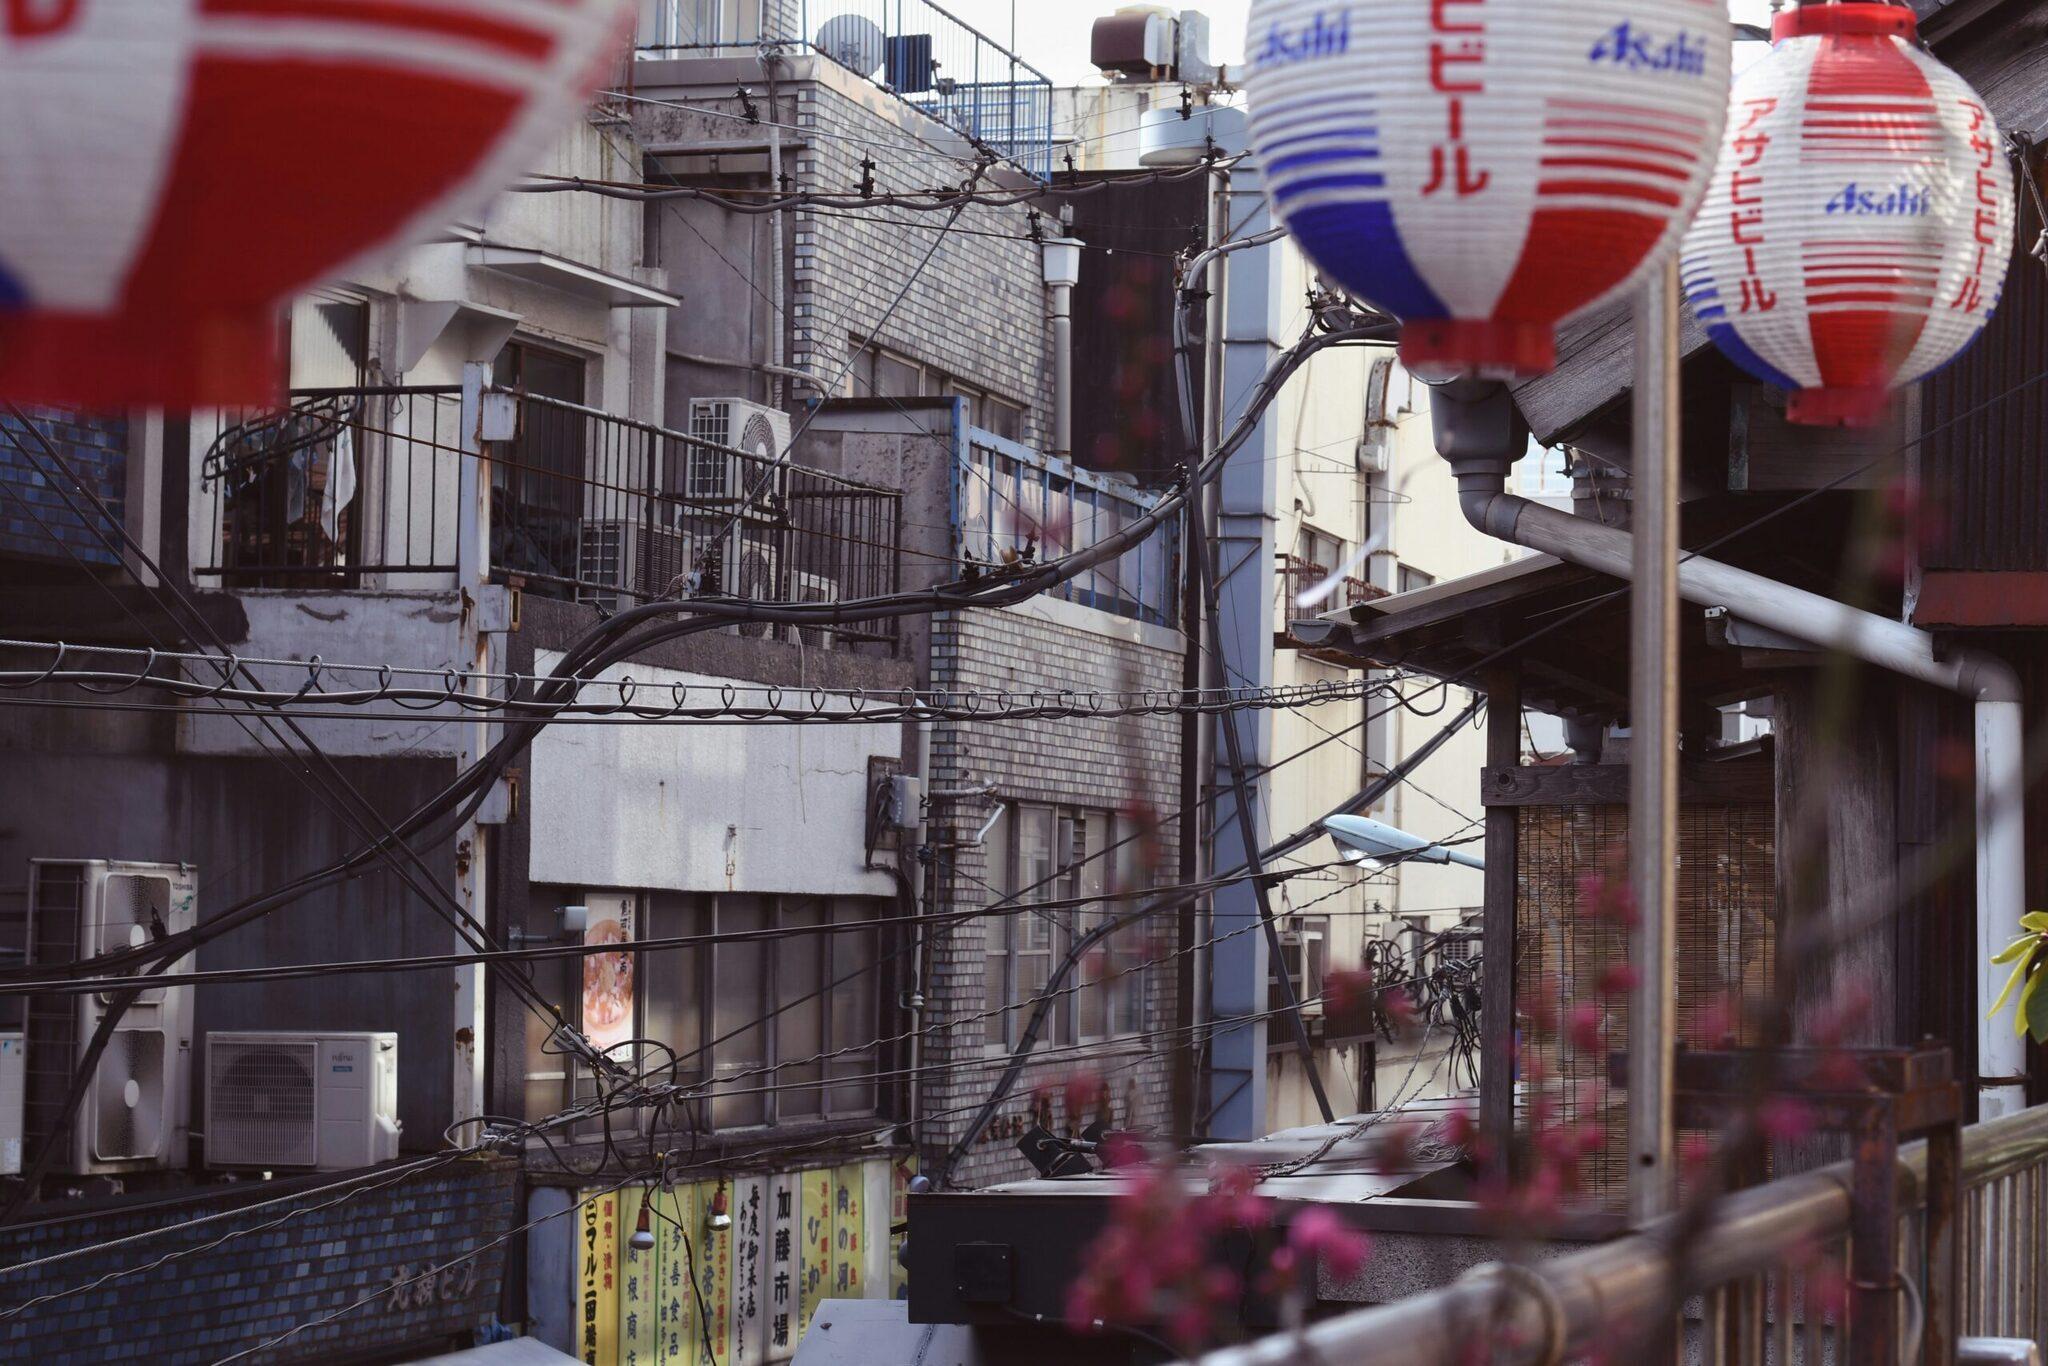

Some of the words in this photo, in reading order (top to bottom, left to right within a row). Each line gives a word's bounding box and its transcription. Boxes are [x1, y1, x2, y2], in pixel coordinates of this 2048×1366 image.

[1589, 20, 1708, 76] Asahi
[1730, 98, 1777, 314] アサヒビール
[1826, 183, 1931, 216] Asahi
[1951, 98, 1998, 314] アサヒビール
[669, 1226, 682, 1357] 多喜食品
[746, 1184, 760, 1318] 毎度御来店
[773, 1186, 792, 1347] 加藤市場
